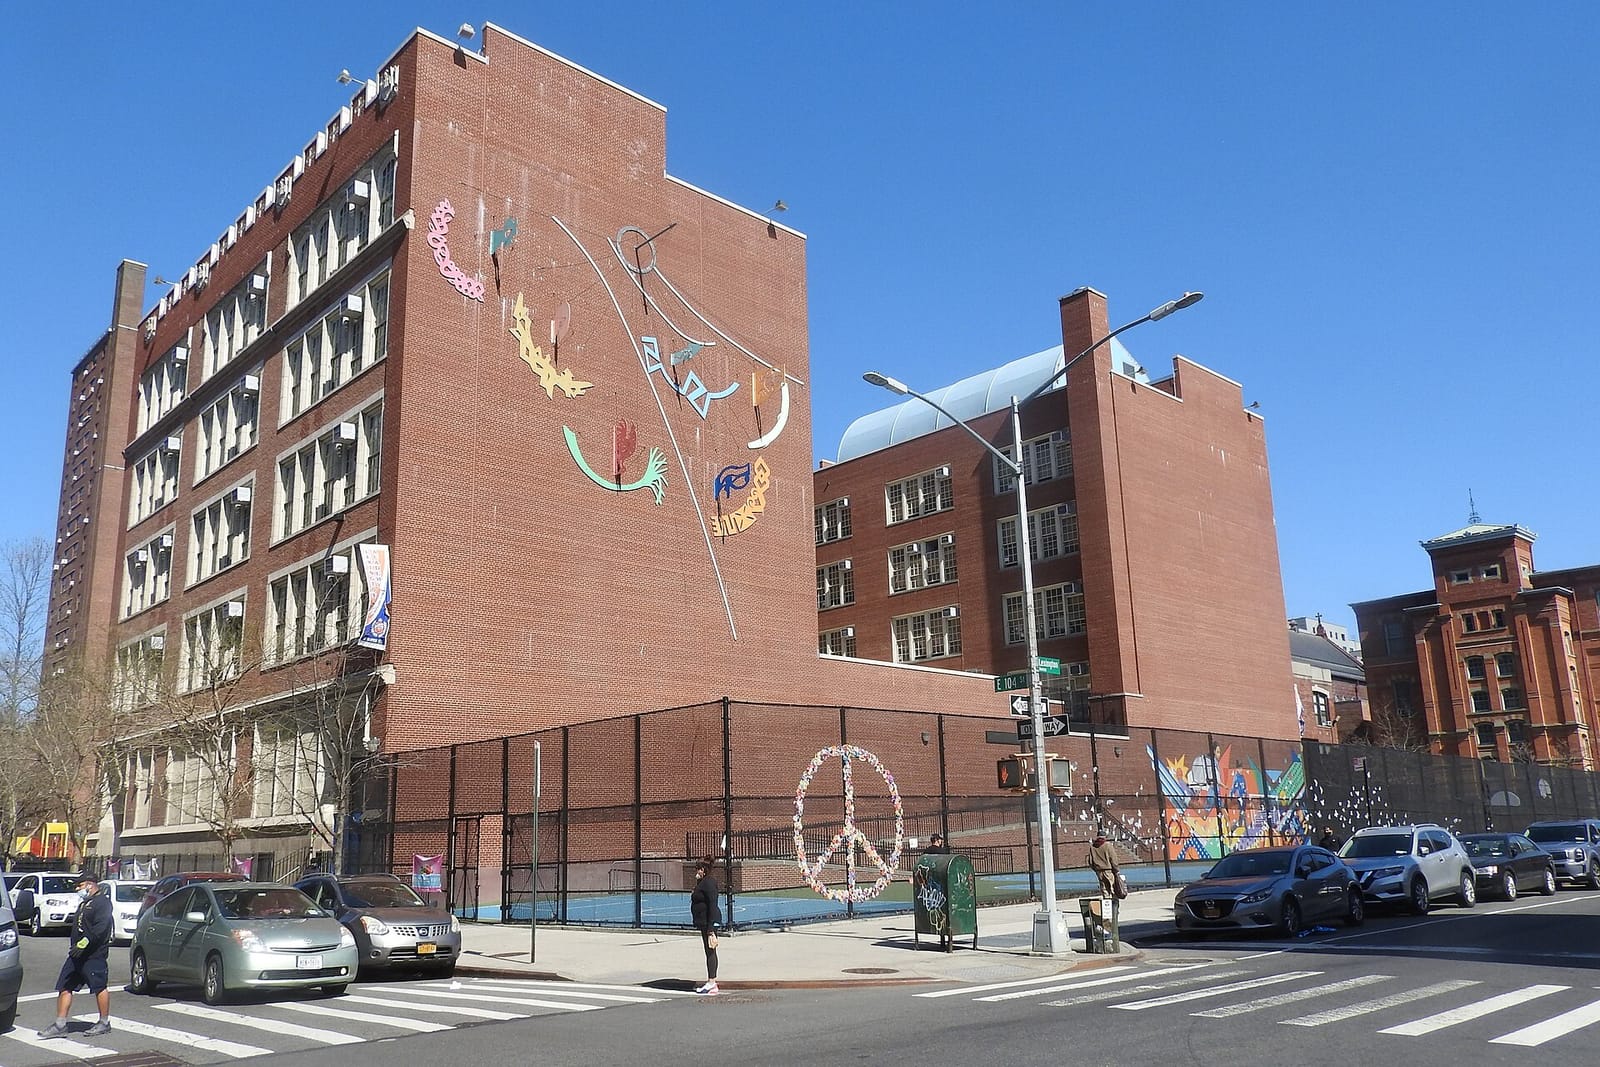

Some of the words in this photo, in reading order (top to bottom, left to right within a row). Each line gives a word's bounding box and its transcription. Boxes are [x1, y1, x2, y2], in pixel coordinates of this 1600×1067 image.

[997, 678, 1002, 690] E
[1004, 677, 1017, 689] 104
[1044, 721, 1061, 732] WAY
